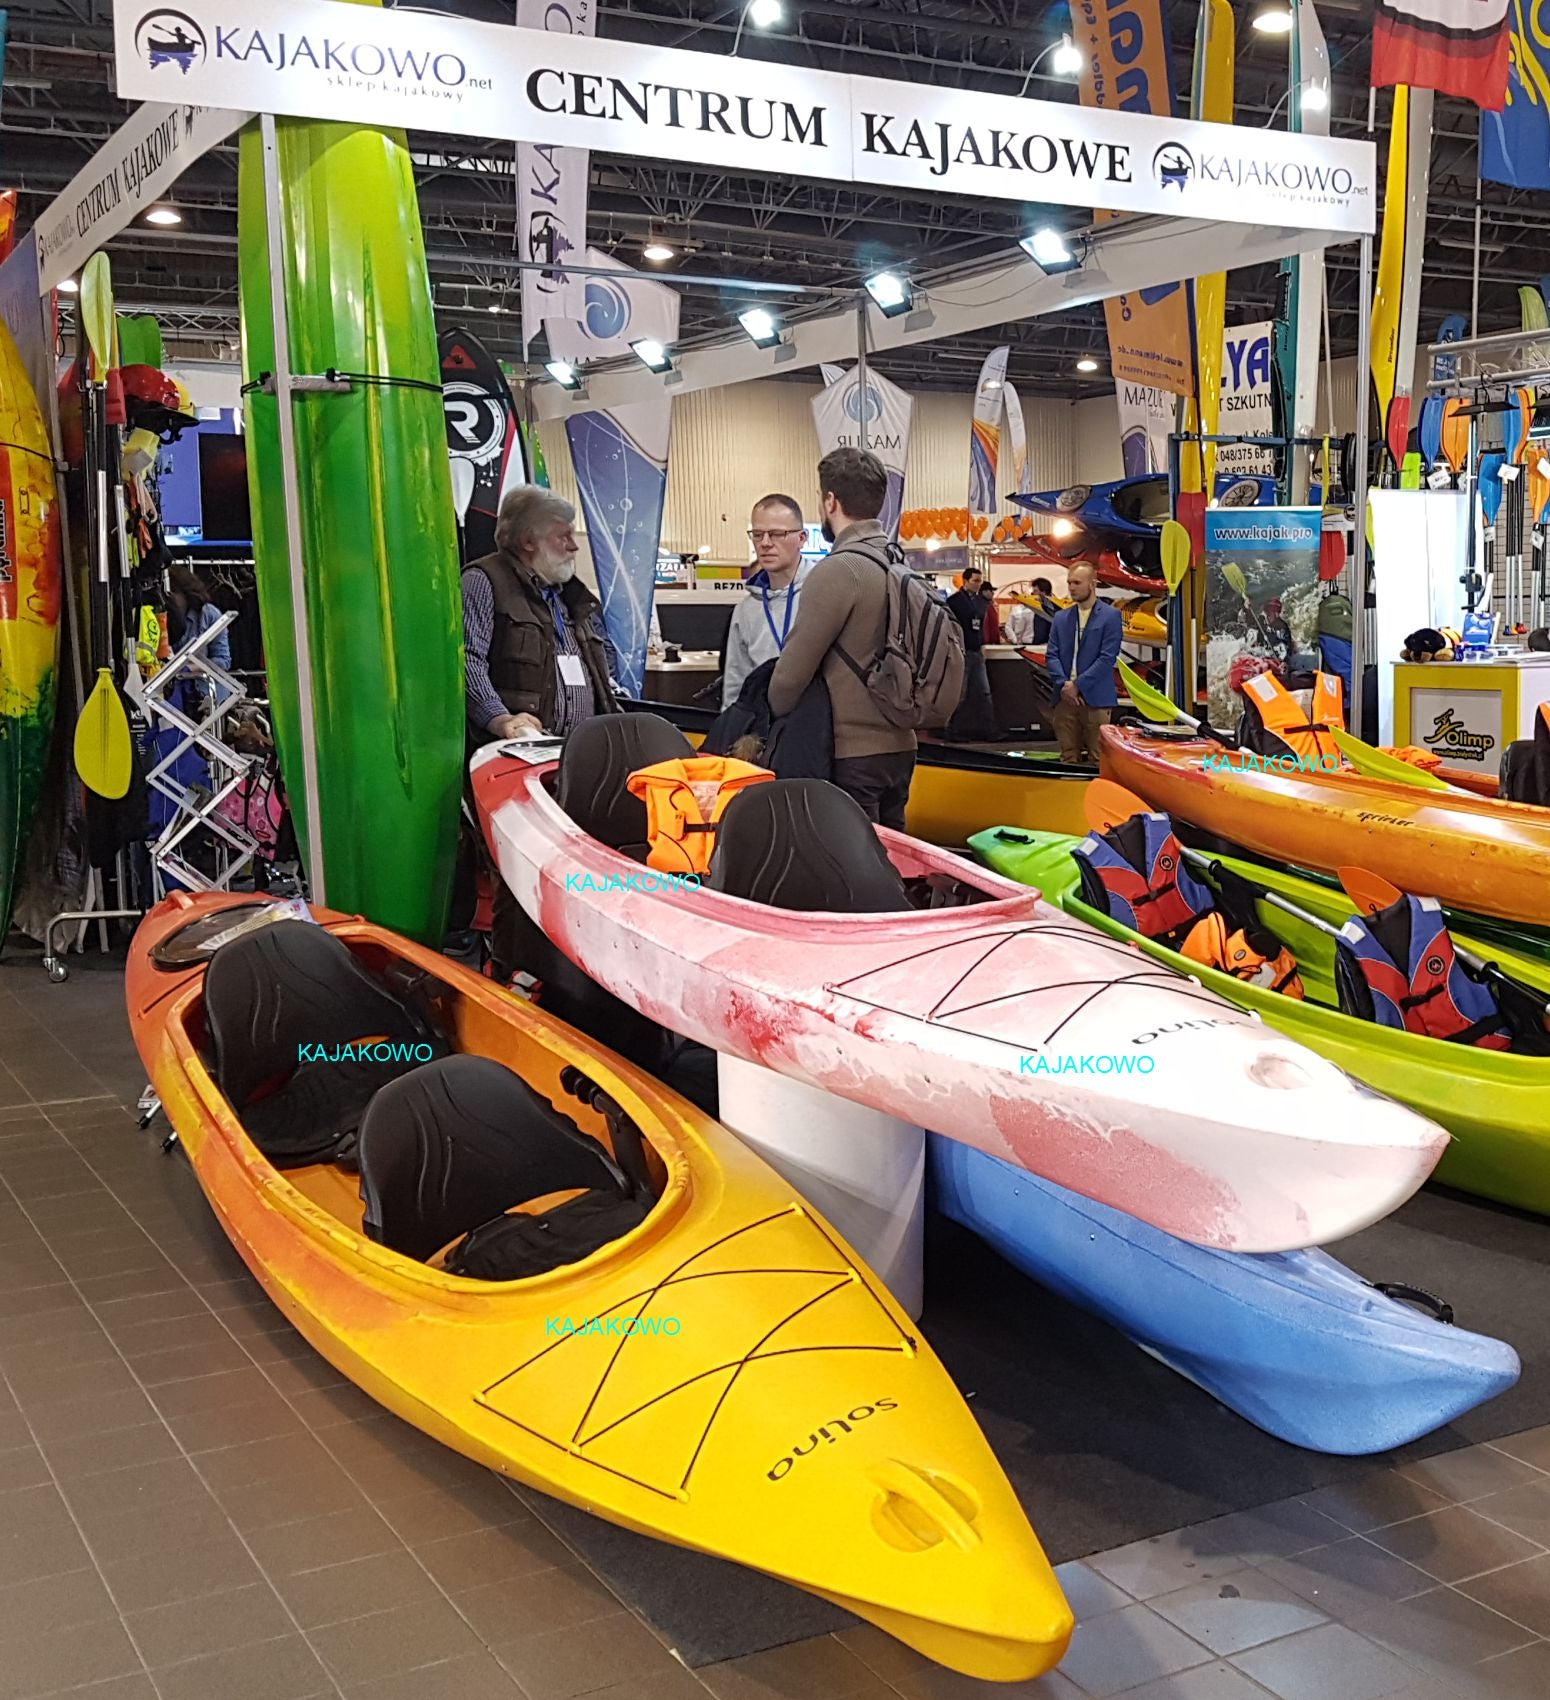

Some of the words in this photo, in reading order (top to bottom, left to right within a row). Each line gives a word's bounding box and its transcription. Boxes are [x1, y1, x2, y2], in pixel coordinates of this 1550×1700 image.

[328, 75, 376, 92] sklep
[526, 68, 828, 147] CENTRUM
[860, 112, 1133, 183] KAJAKOWE
[76, 168, 121, 238] CENTRUM
[122, 109, 179, 199] KAJAKOWE
[1220, 336, 1270, 392] YA
[1214, 525, 1313, 542] www.kajak.pro
[1446, 731, 1494, 751] Olimp
[1131, 1018, 1256, 1045] olina
[767, 1397, 898, 1481] solina
